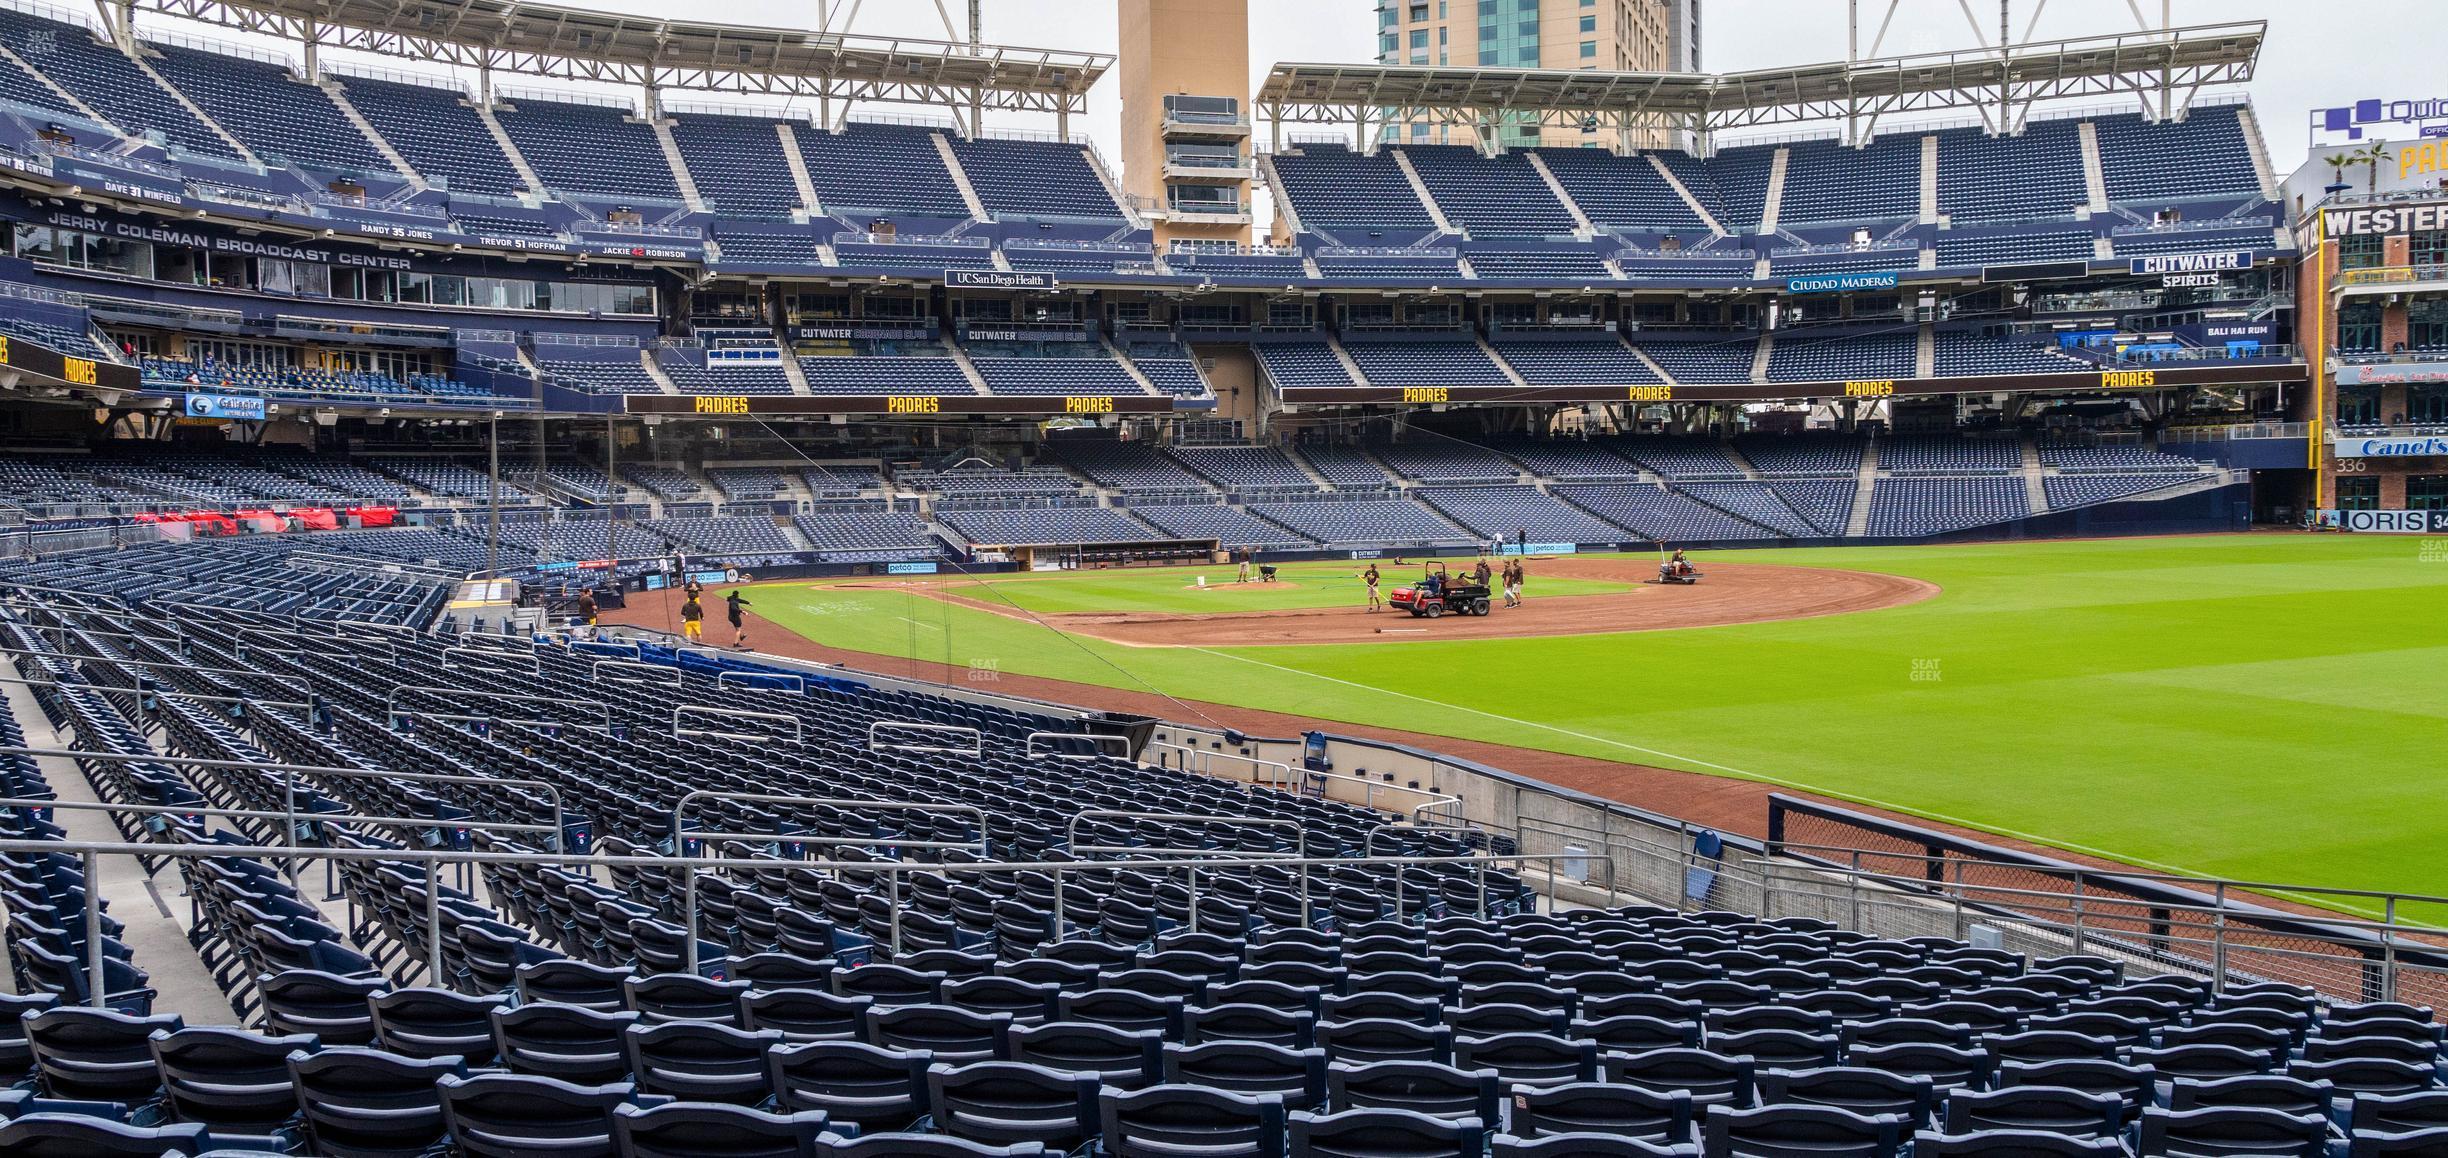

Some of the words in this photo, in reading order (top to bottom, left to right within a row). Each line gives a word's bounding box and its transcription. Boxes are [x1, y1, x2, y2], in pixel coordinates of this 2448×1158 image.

[13, 158, 25, 171] 19
[105, 181, 128, 195] DAVE
[130, 186, 142, 198] 31
[143, 189, 181, 204] WINFIELD
[361, 224, 390, 235] RANDY
[392, 228, 405, 238] 35
[406, 230, 433, 240] JONES
[48, 212, 109, 232] JERRY
[116, 223, 208, 248] COLEMAN
[216, 238, 331, 262] BROADCAST
[338, 252, 412, 270] CENTER
[480, 237, 512, 248] TREVOR
[515, 239, 526, 249] 51
[528, 241, 566, 252] HOFFMAN
[602, 247, 630, 256] JACKIE
[632, 248, 645, 257] 42
[646, 249, 686, 259] ROBINSON
[2144, 253, 2238, 272] CUTWATER
[957, 273, 973, 284] UC
[973, 273, 990, 284] San
[990, 274, 1015, 287] Diego
[1016, 274, 1044, 285] Health
[1790, 278, 1838, 292] CIUDAD
[1841, 275, 1895, 290] MADERAS
[2163, 273, 2219, 288] SPIRITS
[801, 328, 851, 339] CUTWATER
[969, 331, 1016, 341] CUTWATER
[2208, 327, 2228, 336] BALI
[2231, 327, 2245, 335] HAI
[2248, 326, 2268, 335] RUM
[64, 357, 96, 385] PADRES
[2102, 371, 2154, 387] PADRES
[1404, 387, 1448, 402] PADRES
[1629, 386, 1671, 400] PADRES
[1846, 381, 1894, 396] PADRES
[695, 396, 749, 413] PADRES
[888, 396, 939, 412] PADRES
[1066, 397, 1113, 412] PADRES
[2361, 438, 2448, 456] Canel's
[2336, 459, 2366, 472] 336
[2352, 512, 2424, 530] ORIS
[1535, 544, 1555, 552] petco
[890, 564, 912, 572] petco
